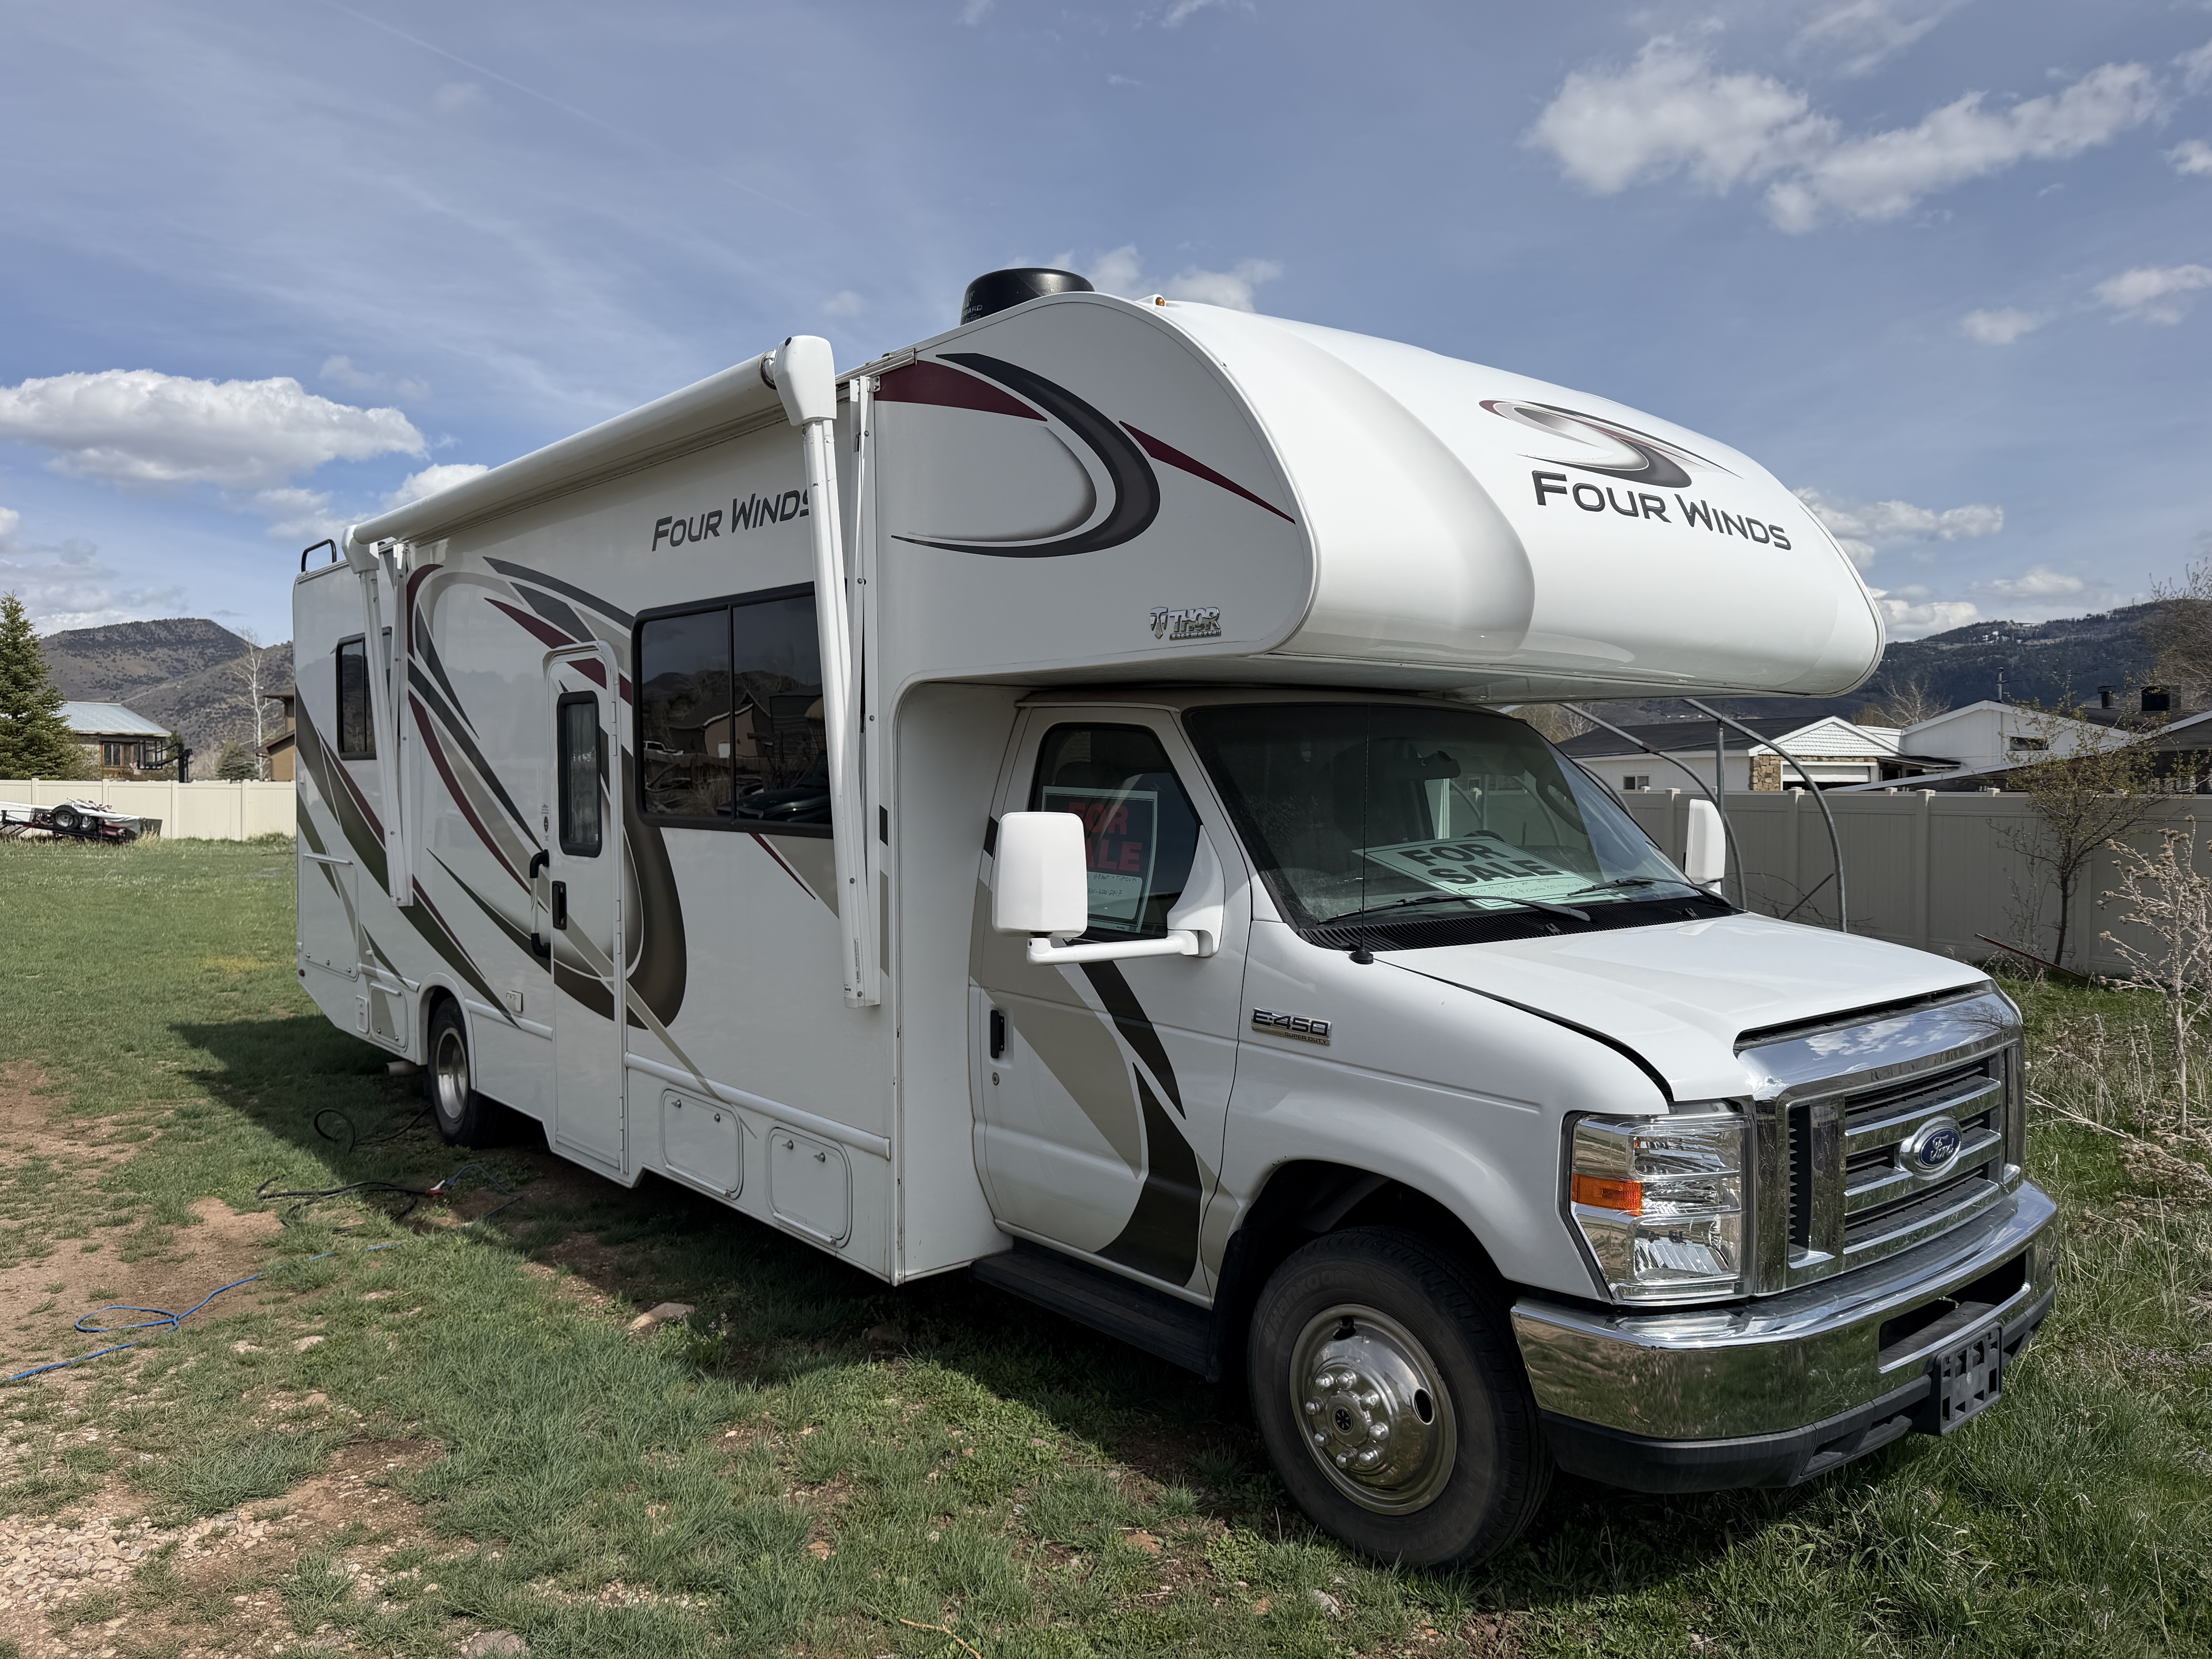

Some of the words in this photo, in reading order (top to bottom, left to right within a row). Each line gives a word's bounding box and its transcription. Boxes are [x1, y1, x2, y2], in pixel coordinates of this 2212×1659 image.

[1532, 470, 1671, 523] FOUR
[1675, 494, 1791, 550] WINDS
[652, 510, 723, 551] FOUR
[1170, 607, 1221, 632] THOR
[1398, 844, 1511, 866] FOR
[1428, 860, 1564, 884] SALE
[1284, 1032, 1306, 1040] SUPER
[1930, 1135, 1954, 1161] Ford
